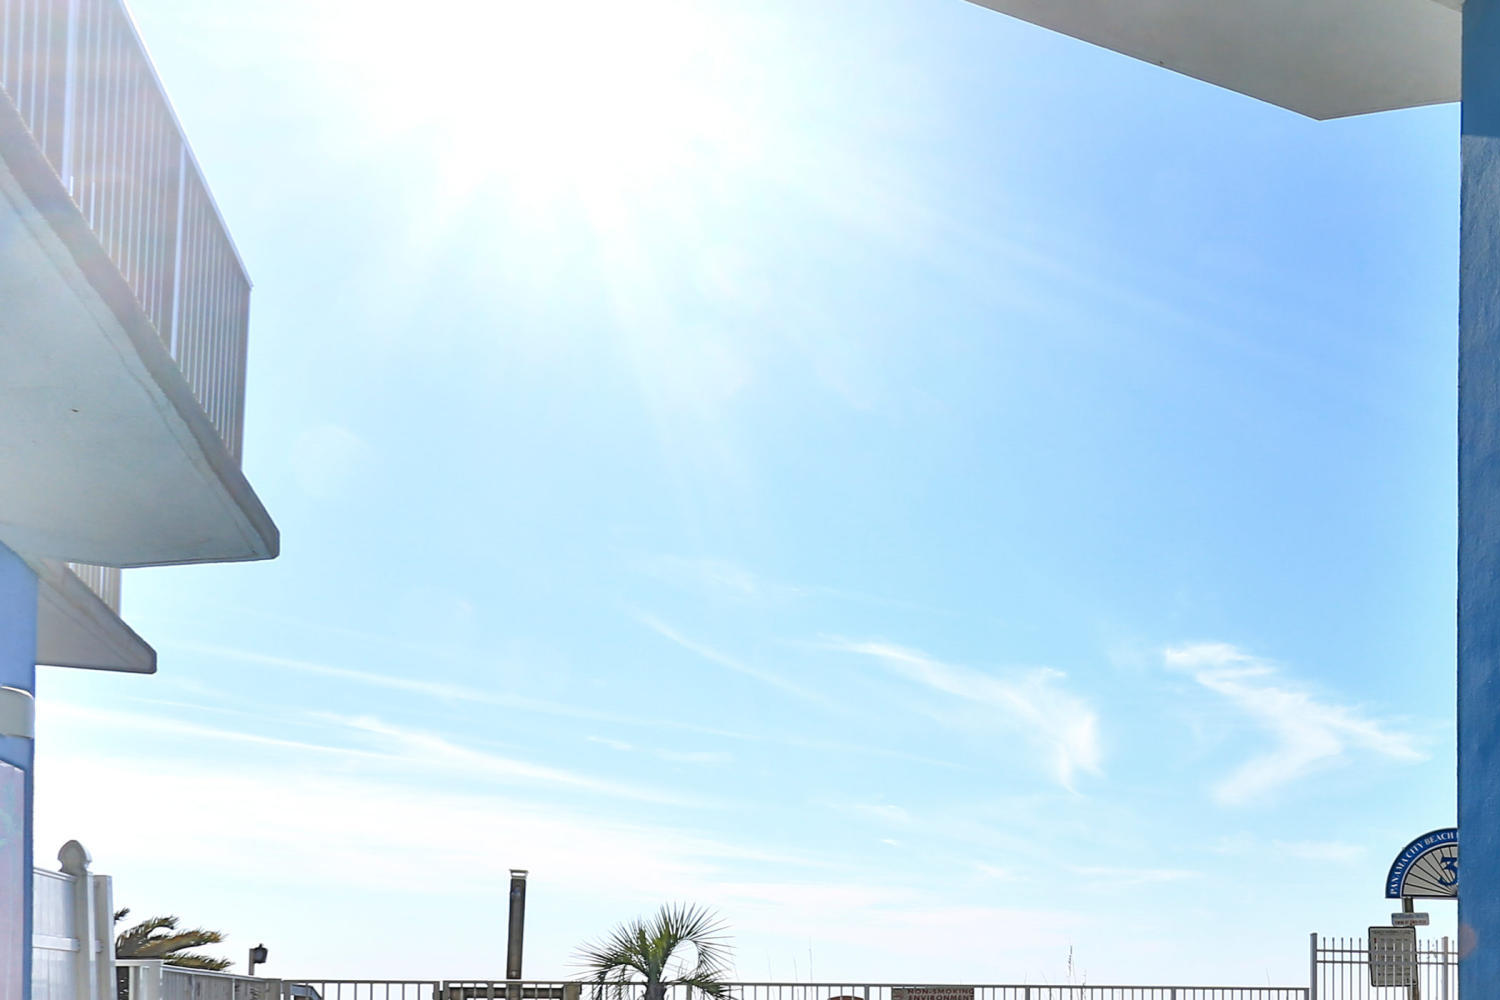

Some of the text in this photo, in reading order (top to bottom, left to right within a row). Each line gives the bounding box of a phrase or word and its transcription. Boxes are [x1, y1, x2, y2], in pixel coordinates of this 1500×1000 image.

[1389, 832, 1454, 895] PANAMA CITY BEACH
